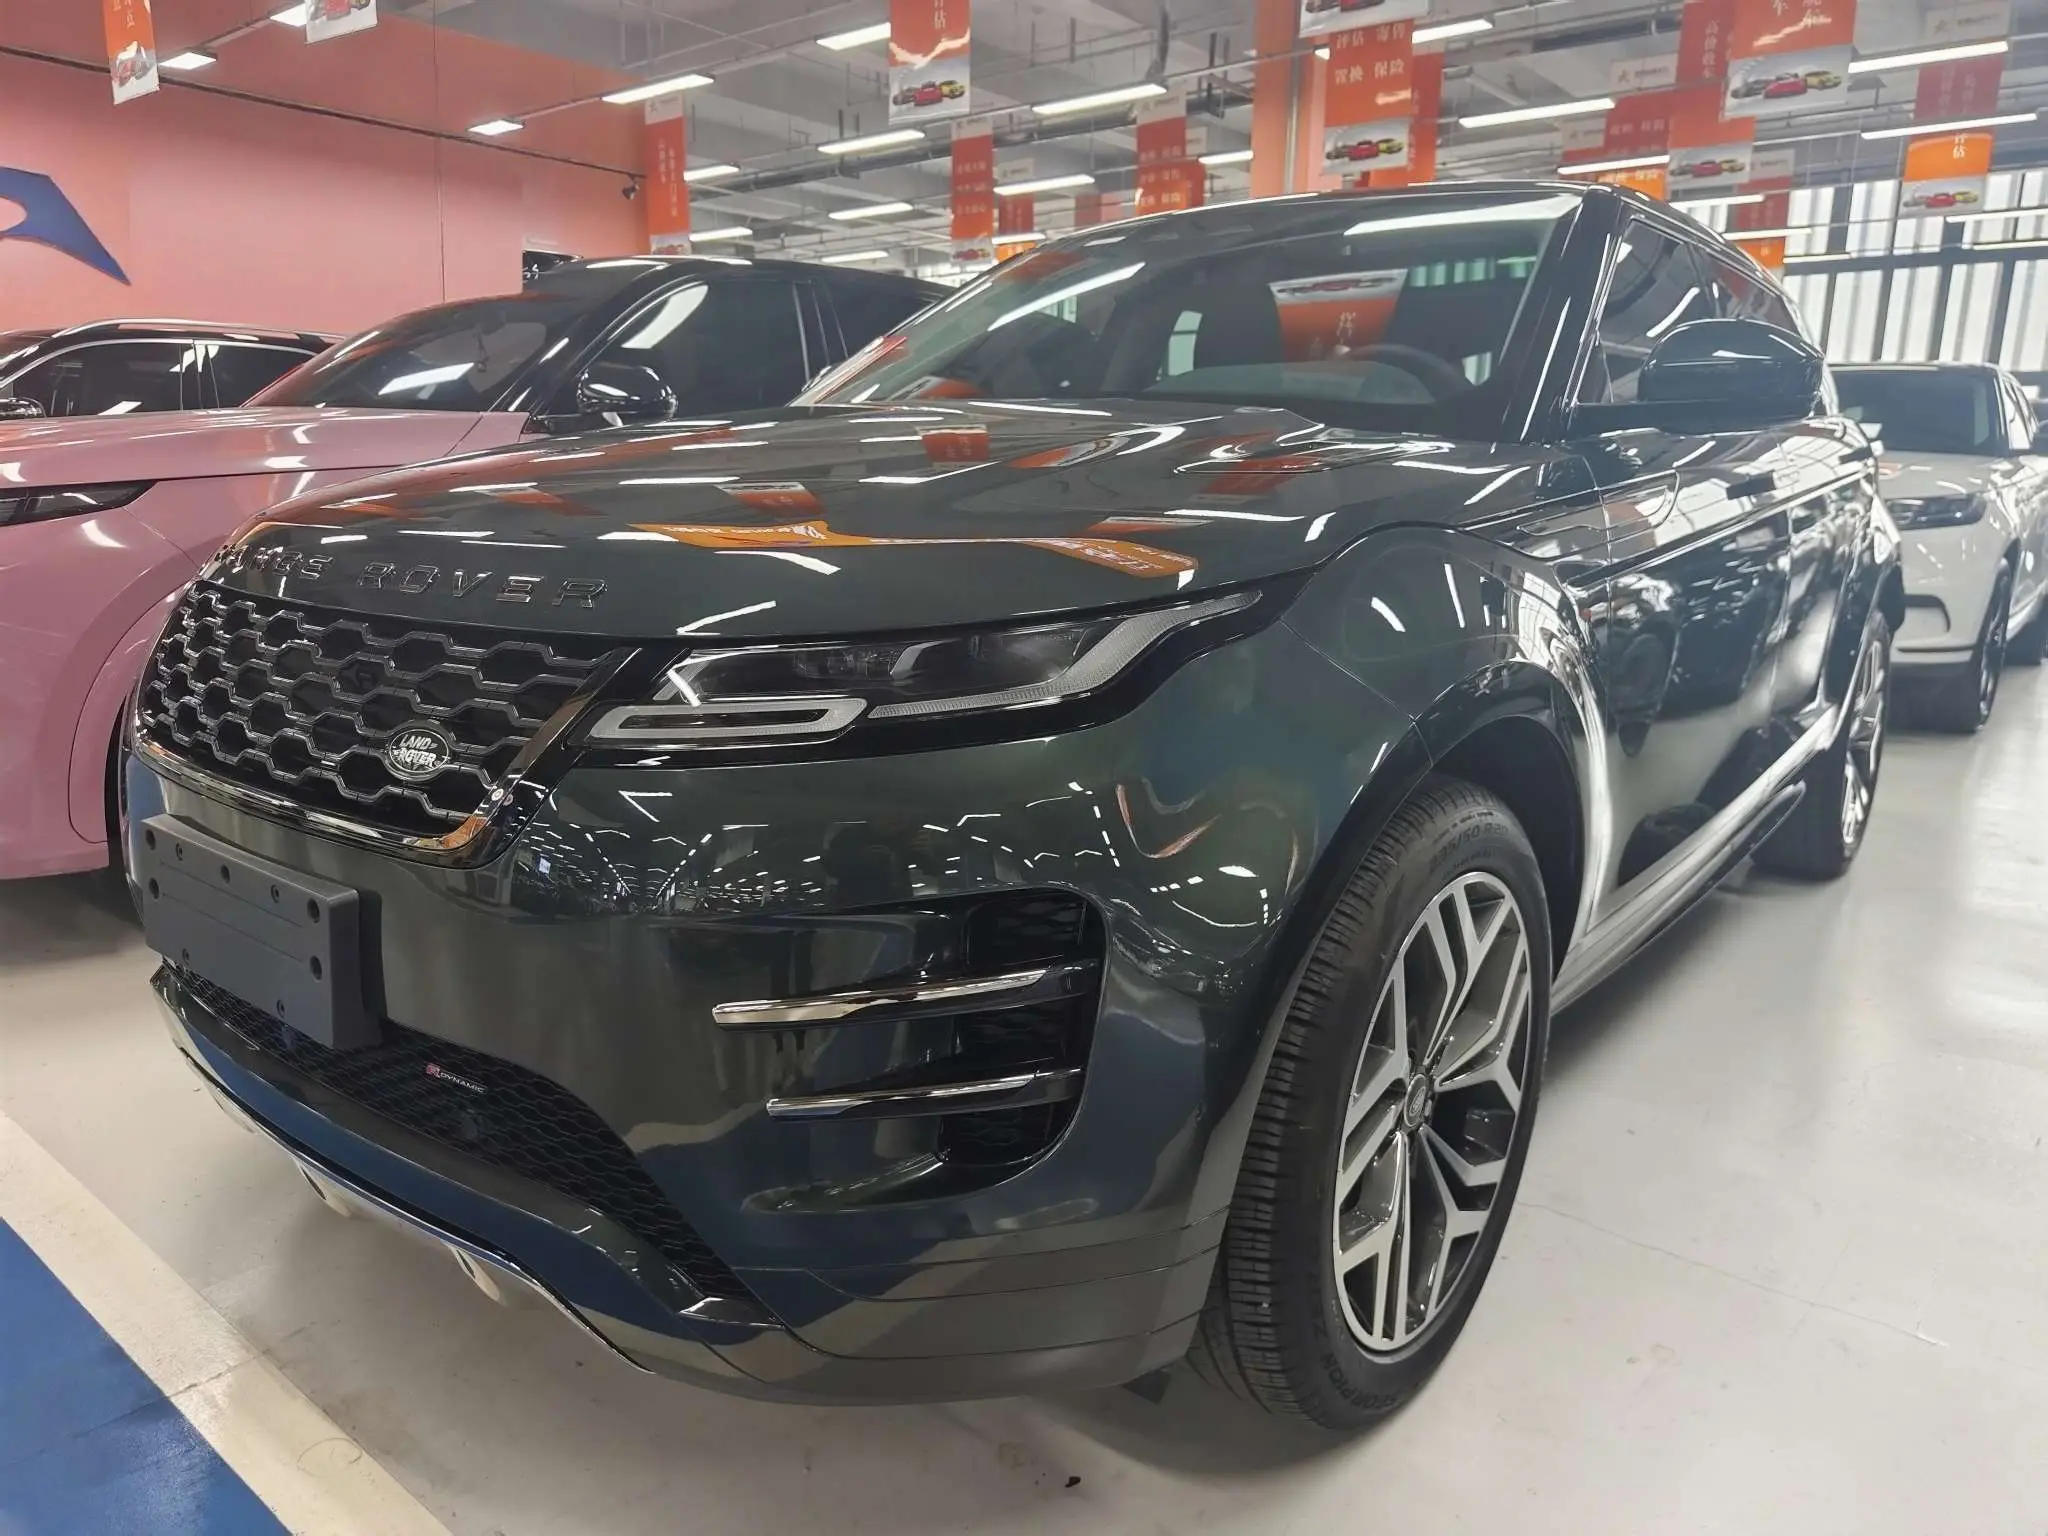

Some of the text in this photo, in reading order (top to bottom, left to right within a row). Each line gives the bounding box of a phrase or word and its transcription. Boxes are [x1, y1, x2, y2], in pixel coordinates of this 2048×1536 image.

[1374, 58, 1405, 80] 保险
[356, 561, 609, 608] ROVER
[399, 734, 432, 750] LAND
[397, 748, 437, 768] ROVER
[440, 1072, 485, 1093] DYNAMIC
